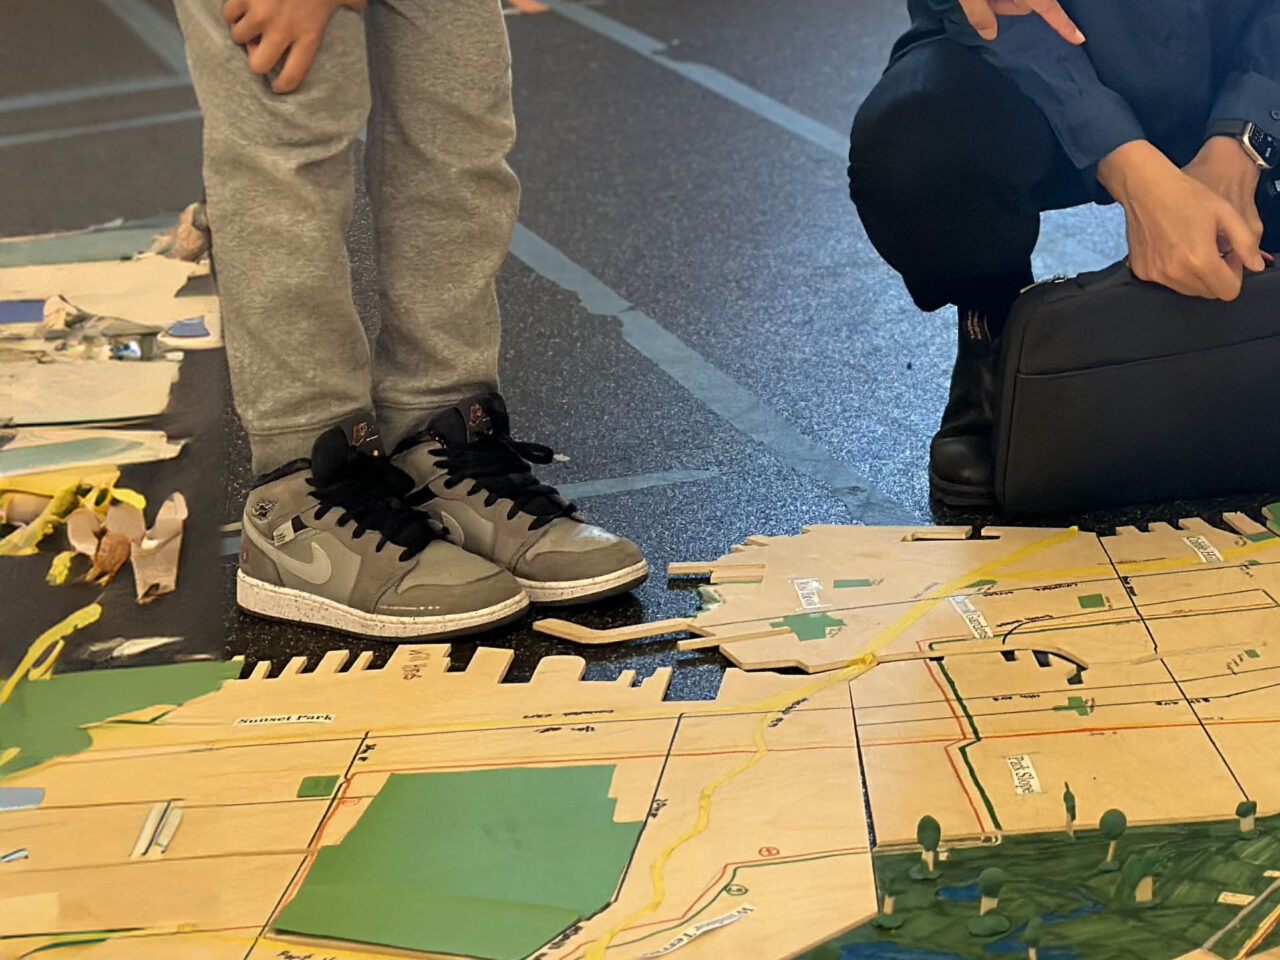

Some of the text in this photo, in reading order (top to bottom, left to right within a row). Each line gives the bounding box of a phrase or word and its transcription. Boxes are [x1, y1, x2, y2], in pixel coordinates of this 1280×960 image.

[297, 714, 333, 722] Park
[1008, 754, 1035, 794] Park Slope
